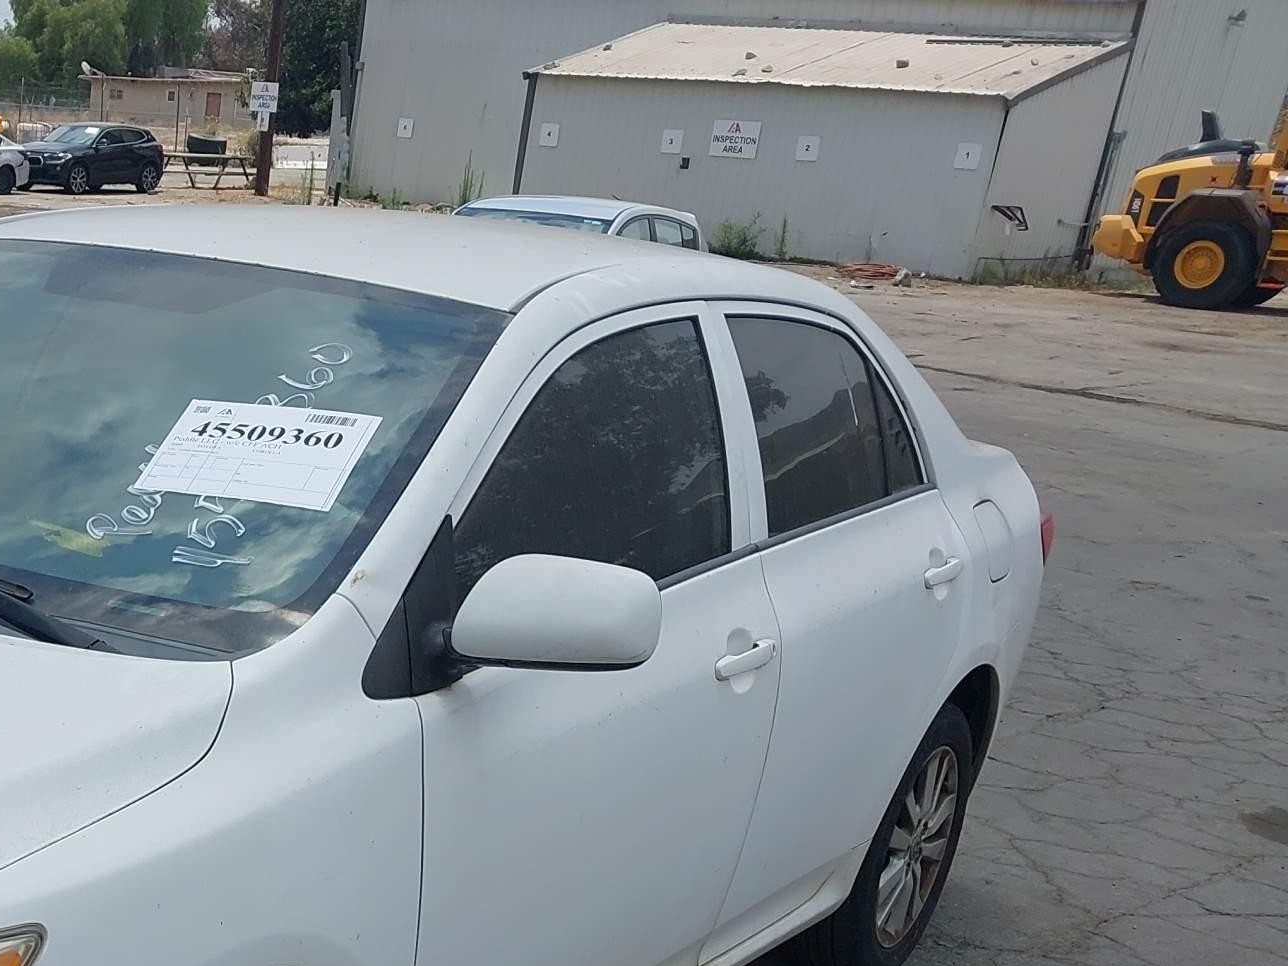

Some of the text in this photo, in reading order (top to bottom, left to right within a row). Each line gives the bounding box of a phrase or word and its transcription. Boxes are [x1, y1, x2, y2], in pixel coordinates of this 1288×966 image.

[712, 134, 758, 146] INSPECTION
[722, 145, 744, 154] AREA
[805, 144, 811, 152] 2
[965, 151, 970, 159] 1
[191, 420, 344, 450] 45509360
